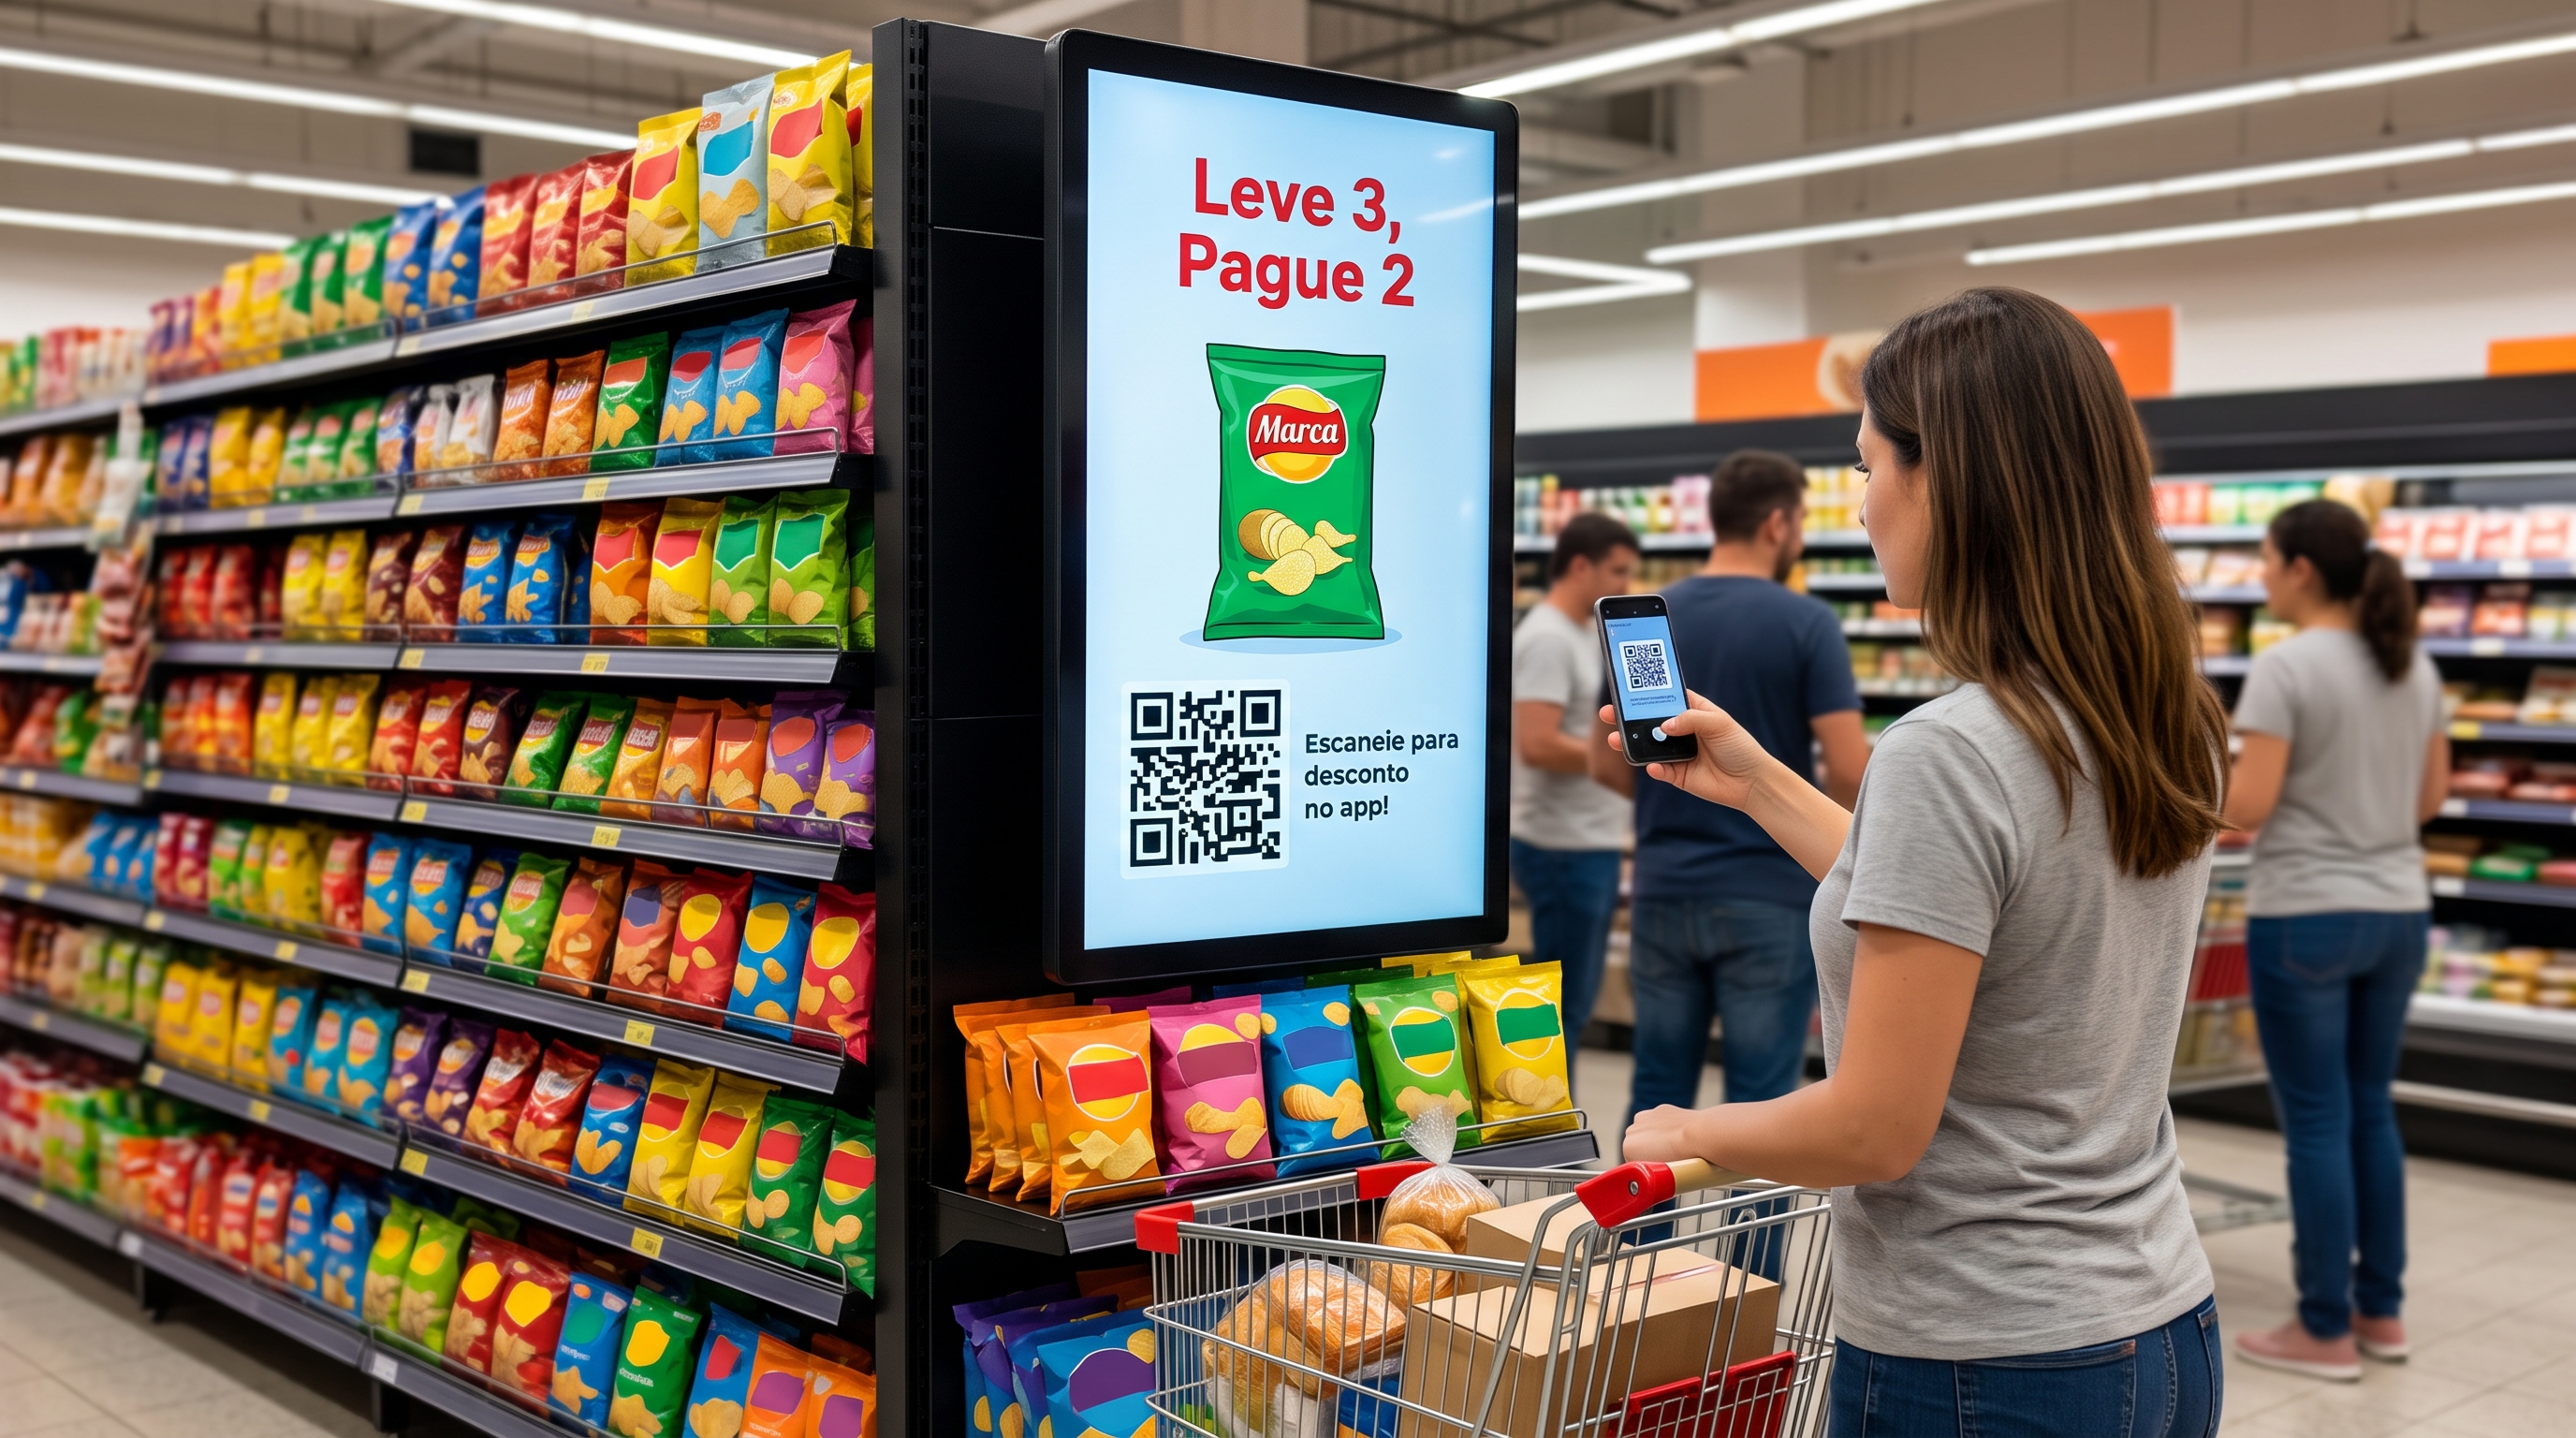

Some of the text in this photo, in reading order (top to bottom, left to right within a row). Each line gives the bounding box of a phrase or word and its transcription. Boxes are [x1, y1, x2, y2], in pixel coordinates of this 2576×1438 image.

[1194, 157, 1401, 243] Leve 3,
[1178, 232, 1415, 310] Pague 2
[1254, 414, 1339, 444] Marca
[1305, 729, 1458, 755] Escaneie para
[1304, 763, 1409, 786] desconto
[1305, 795, 1388, 821] no app!
